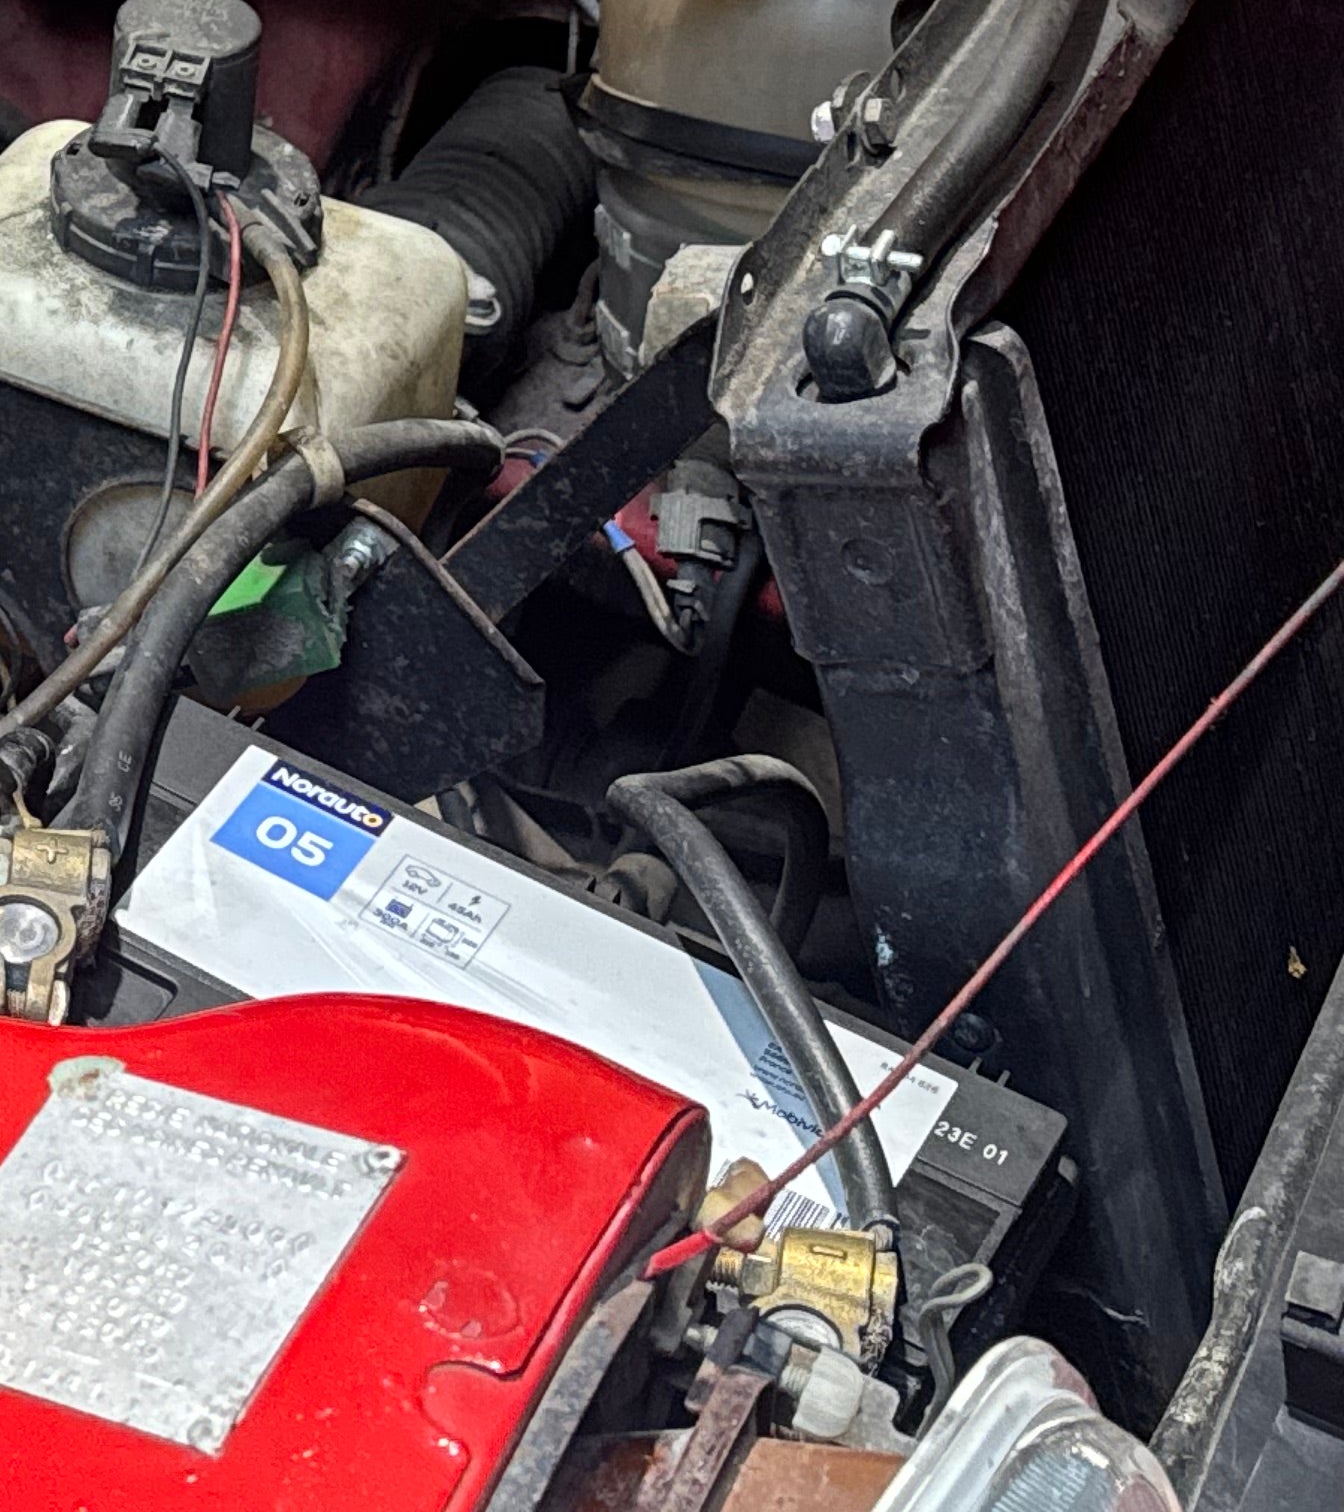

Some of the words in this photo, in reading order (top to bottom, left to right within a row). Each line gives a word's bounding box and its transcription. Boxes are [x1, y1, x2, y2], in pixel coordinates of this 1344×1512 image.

[271, 766, 384, 828] Norauto
[255, 815, 334, 867] 05
[934, 1121, 978, 1150] 23E
[983, 1144, 1009, 1166] 01
